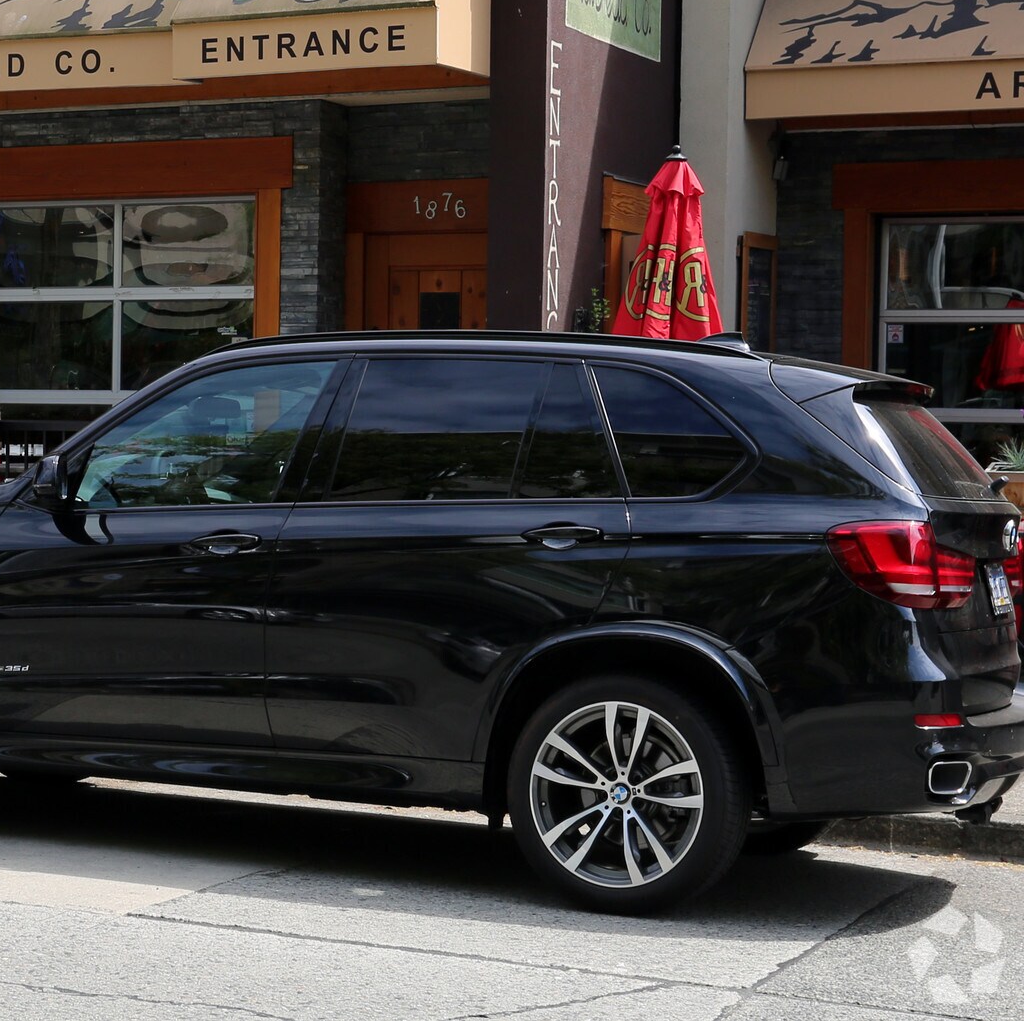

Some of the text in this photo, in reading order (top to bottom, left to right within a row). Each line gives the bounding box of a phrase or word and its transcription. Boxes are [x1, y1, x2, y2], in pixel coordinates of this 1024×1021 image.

[202, 25, 406, 64] ENTRANCE
[55, 49, 115, 75] CO.
[413, 192, 466, 220] 1876
